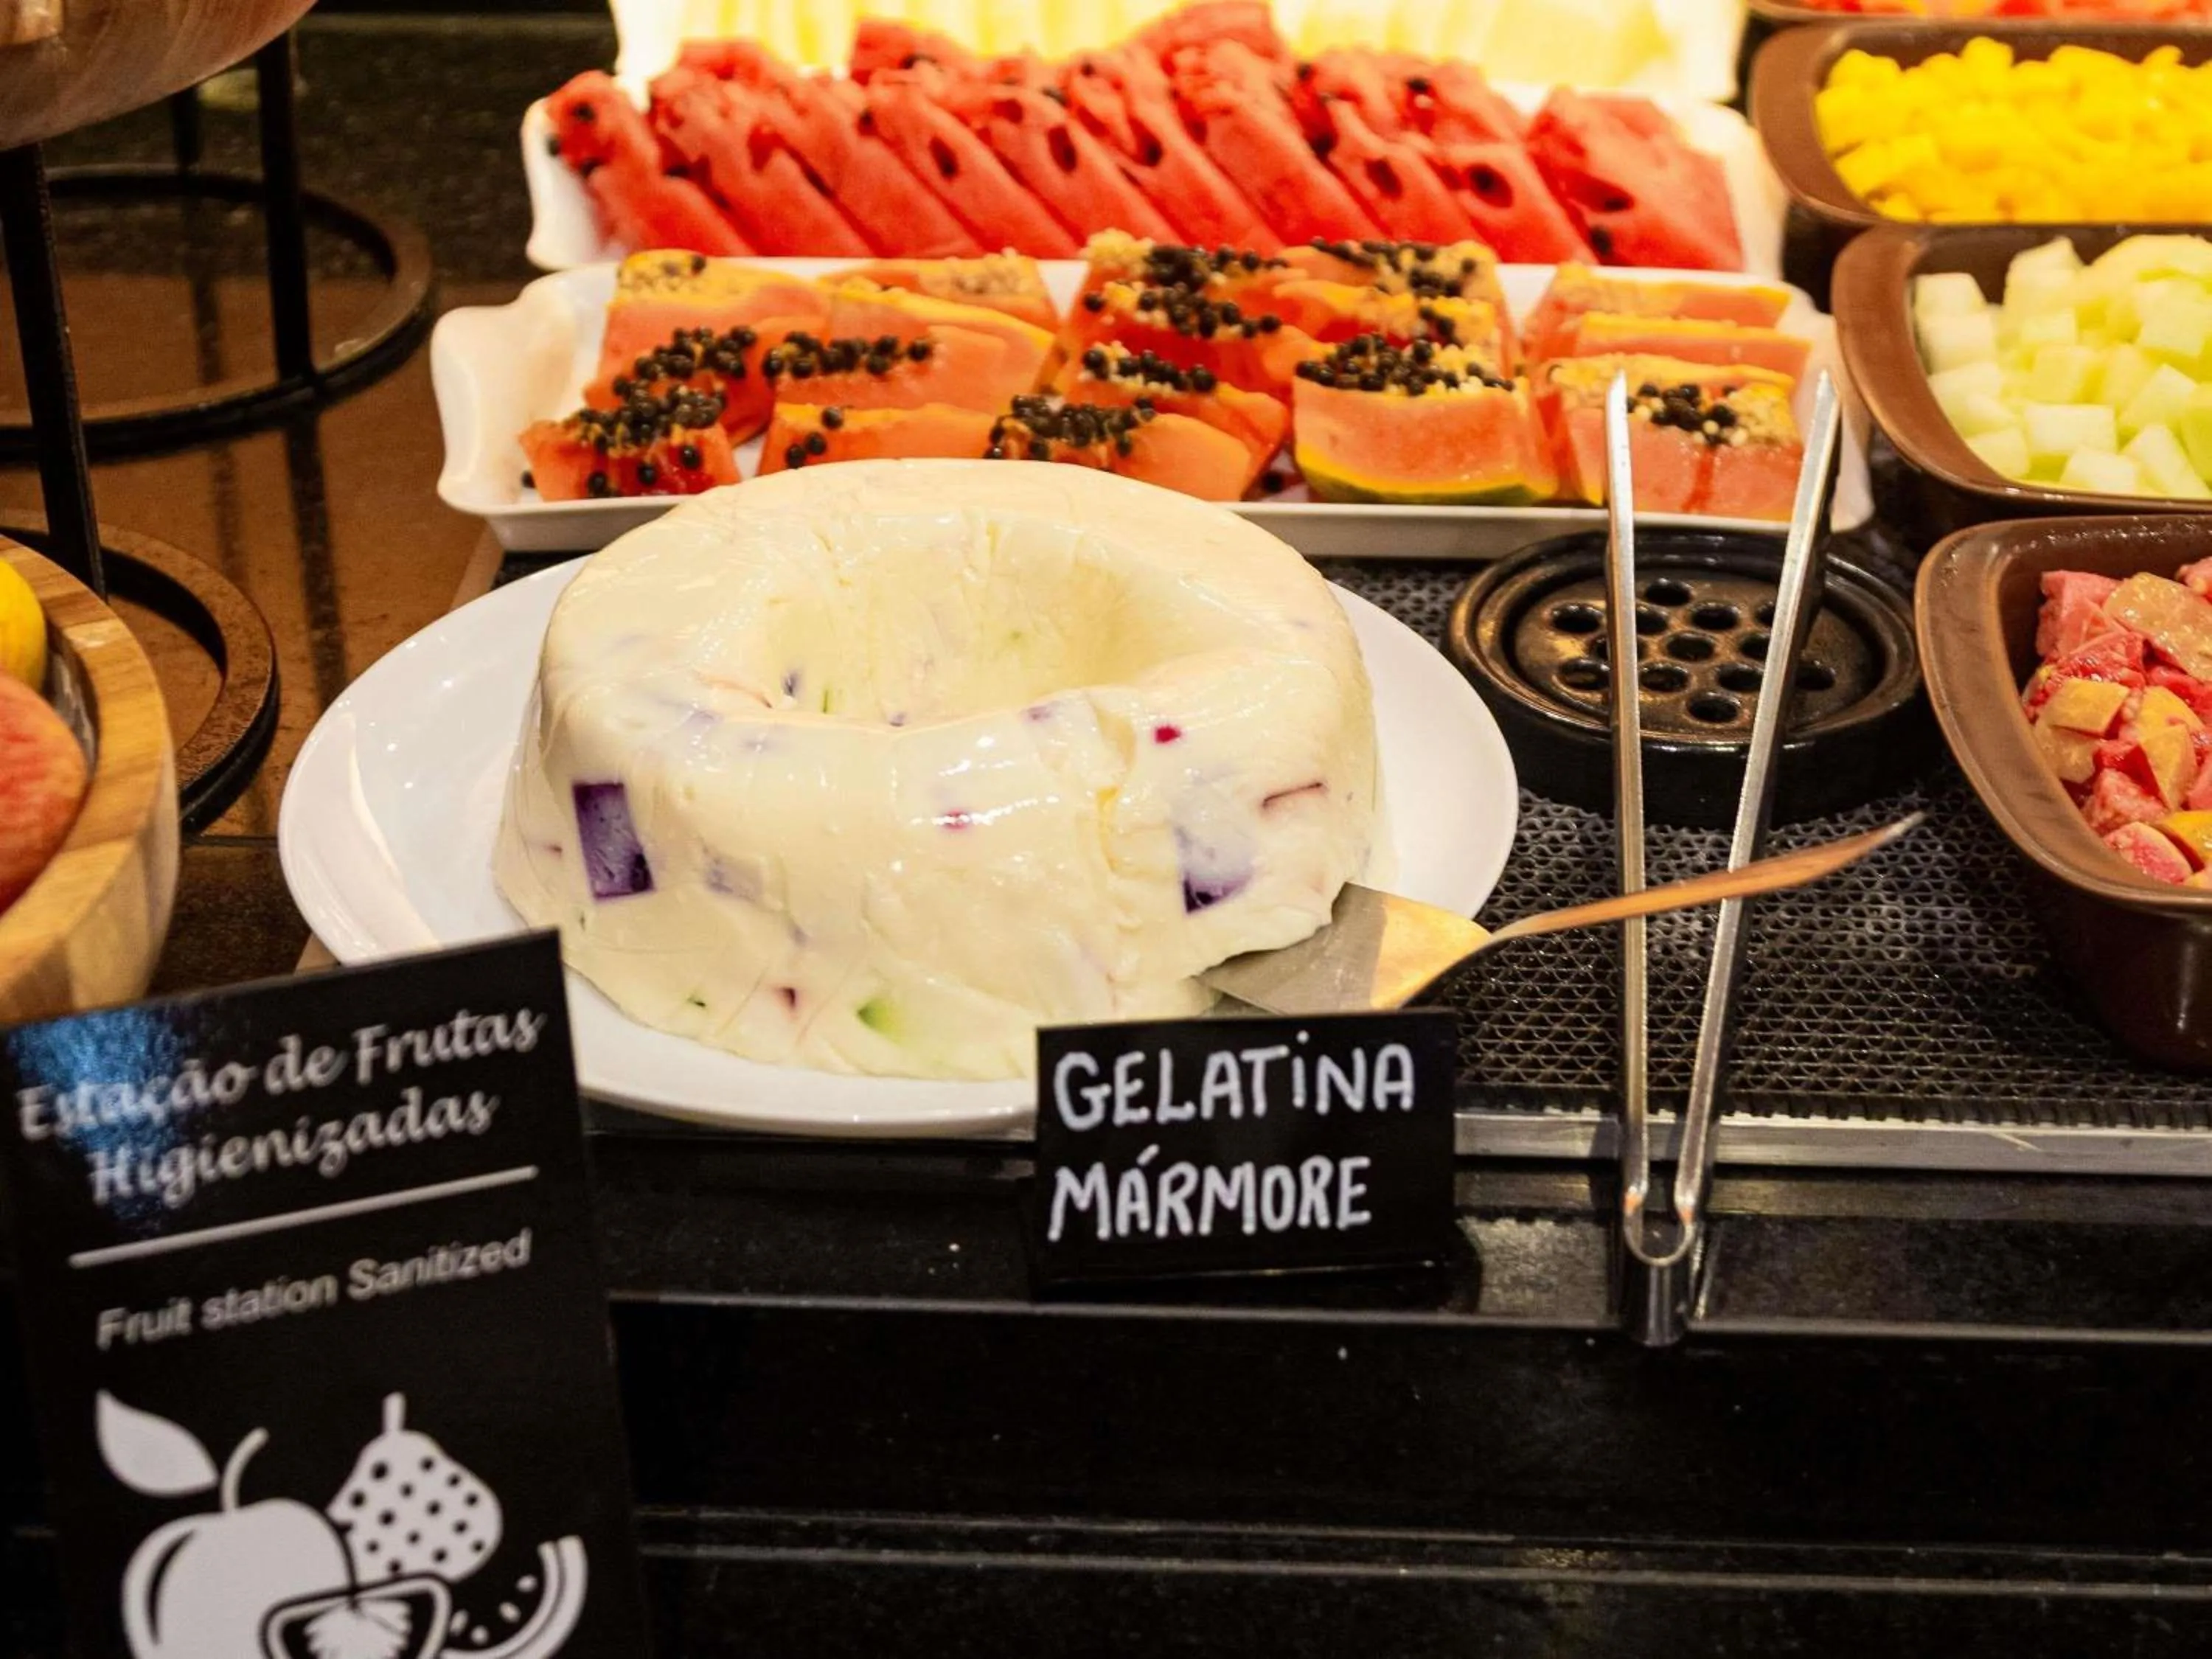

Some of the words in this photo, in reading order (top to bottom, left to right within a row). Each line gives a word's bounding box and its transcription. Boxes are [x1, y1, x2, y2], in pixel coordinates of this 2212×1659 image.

[18, 1058, 257, 1140] Estação
[264, 1034, 345, 1096] de
[352, 1007, 545, 1084] Frutas
[86, 1085, 499, 1207] Higienizadas
[1048, 1144, 1371, 1242] MÁRMORE
[97, 1298, 192, 1351] Fruit
[201, 1276, 339, 1329] station
[348, 1227, 532, 1299] Sanitized
